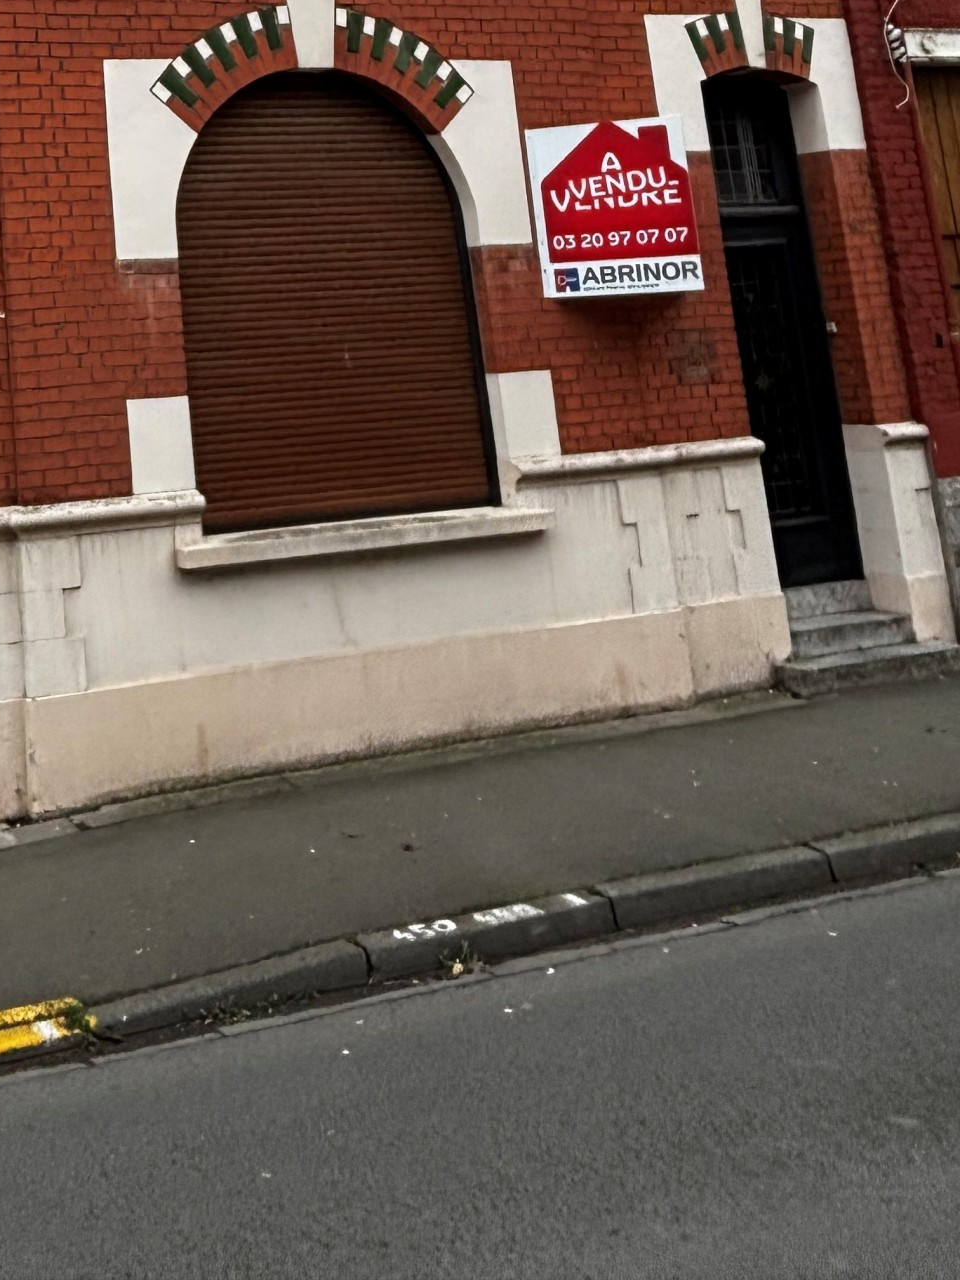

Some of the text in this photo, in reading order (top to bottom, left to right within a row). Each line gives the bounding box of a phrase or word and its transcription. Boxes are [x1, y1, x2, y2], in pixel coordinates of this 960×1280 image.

[601, 151, 622, 173] A
[568, 165, 667, 200] VENDU
[553, 226, 689, 250] 03 20 97 07 07
[582, 260, 700, 286] ABRINOR
